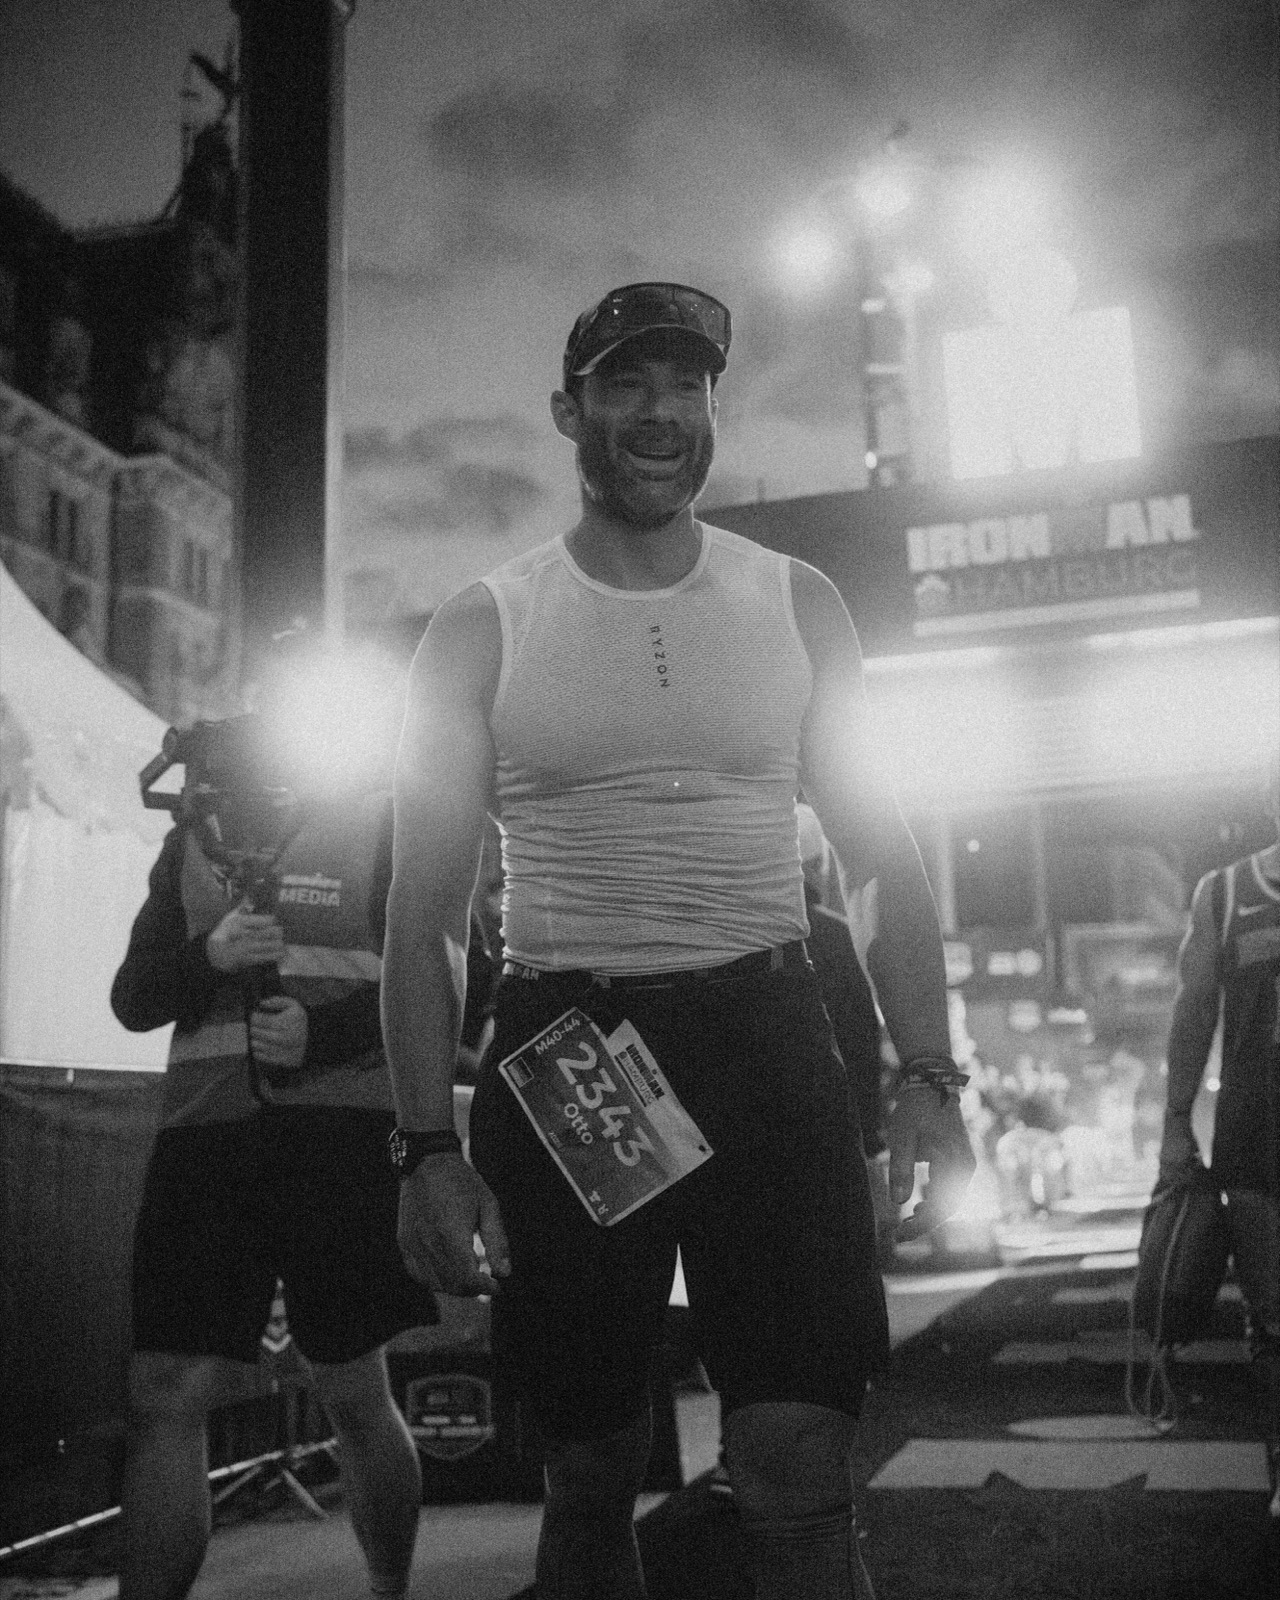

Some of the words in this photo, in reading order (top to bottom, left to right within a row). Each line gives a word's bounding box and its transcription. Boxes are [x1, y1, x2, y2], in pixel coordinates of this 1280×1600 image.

[906, 495, 1195, 572] IRONAN
[953, 547, 1197, 604] HAMBURG
[650, 625, 671, 687] RYZON
[279, 887, 340, 907] MEDIA
[534, 1018, 581, 1054] M40-44
[622, 1057, 656, 1105] HAMBURG
[625, 1043, 666, 1100] IRONMAN
[556, 1042, 657, 1167] 2343
[564, 1103, 593, 1144] Otto
